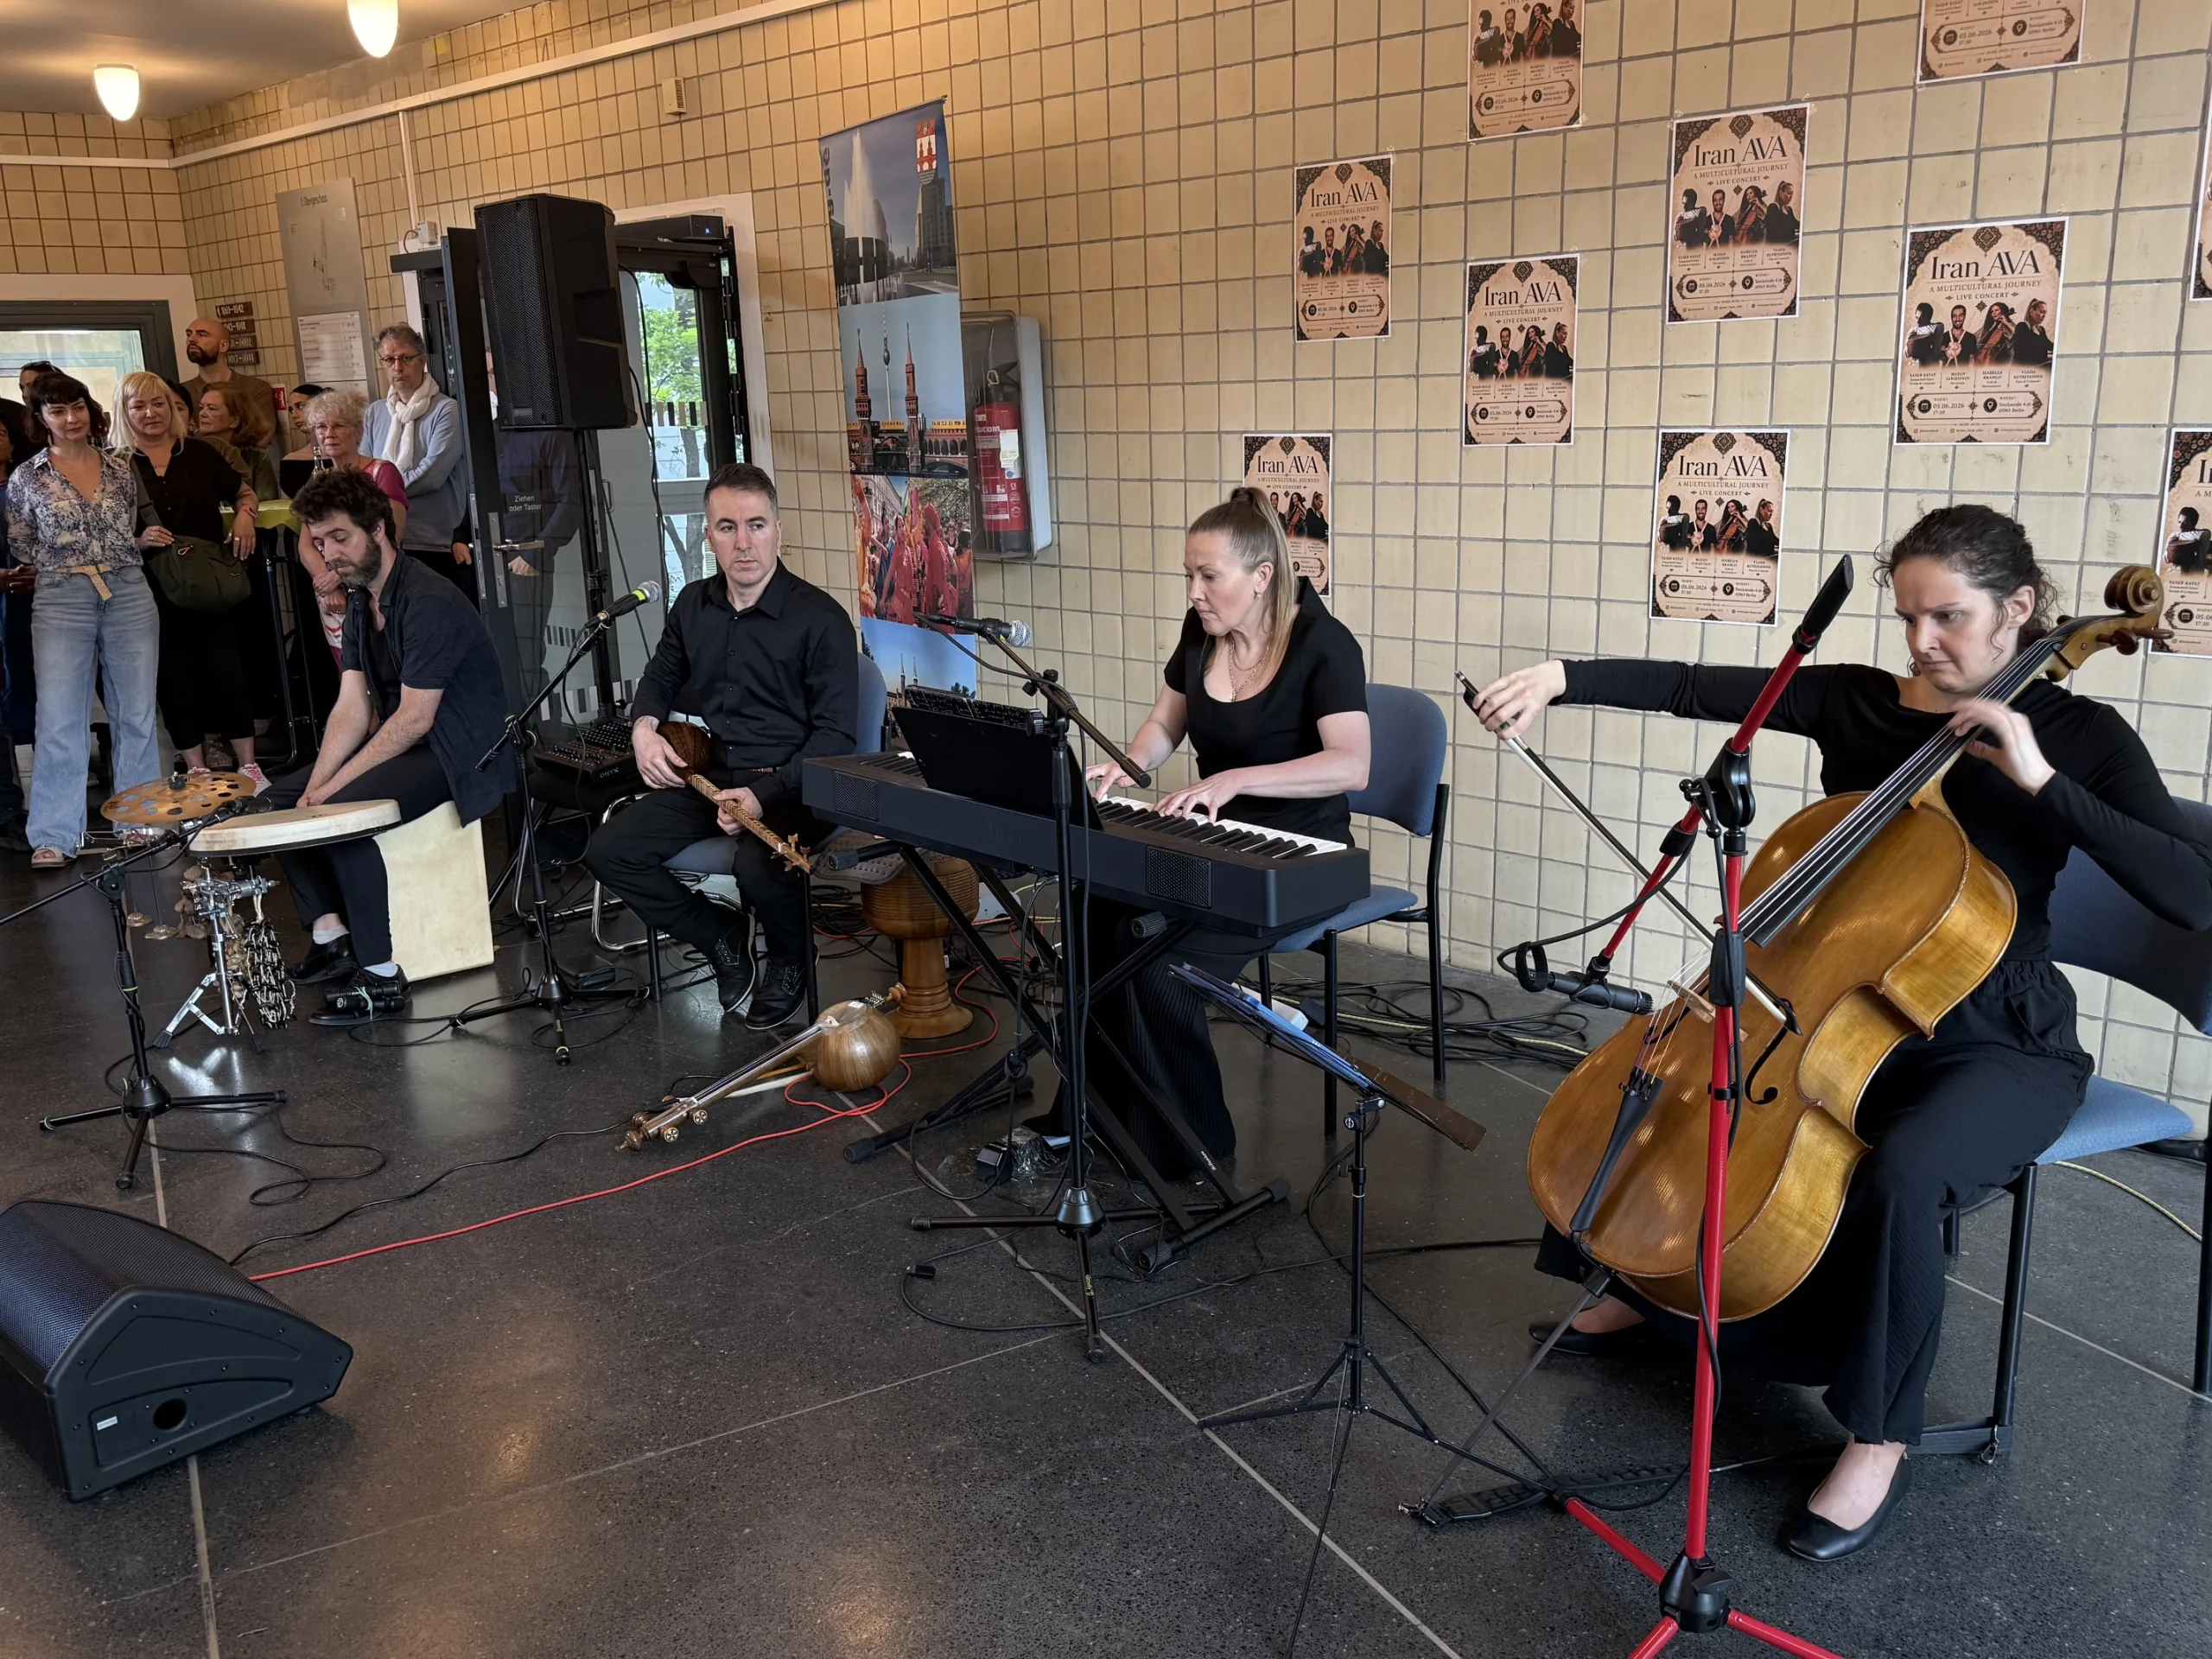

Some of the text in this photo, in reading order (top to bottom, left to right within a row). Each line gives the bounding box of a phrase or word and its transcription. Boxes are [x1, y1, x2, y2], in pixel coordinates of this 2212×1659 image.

[1694, 136, 1788, 167] Iran AVA
[1699, 167, 1756, 178] MULTICULTURAL
[1757, 163, 1789, 174] JOURNEY
[1311, 181, 1378, 207] Iran AVA
[1315, 208, 1355, 217] MULTICULTURAL
[1931, 250, 2041, 279] Iran AVA
[1484, 281, 1562, 306] Iran AVA
[1936, 282, 2003, 292] MULTICULTURAL
[2005, 280, 2042, 289] JOURNEY
[1258, 455, 1318, 474] Iran AVA
[1679, 455, 1768, 476] Iran AVA
